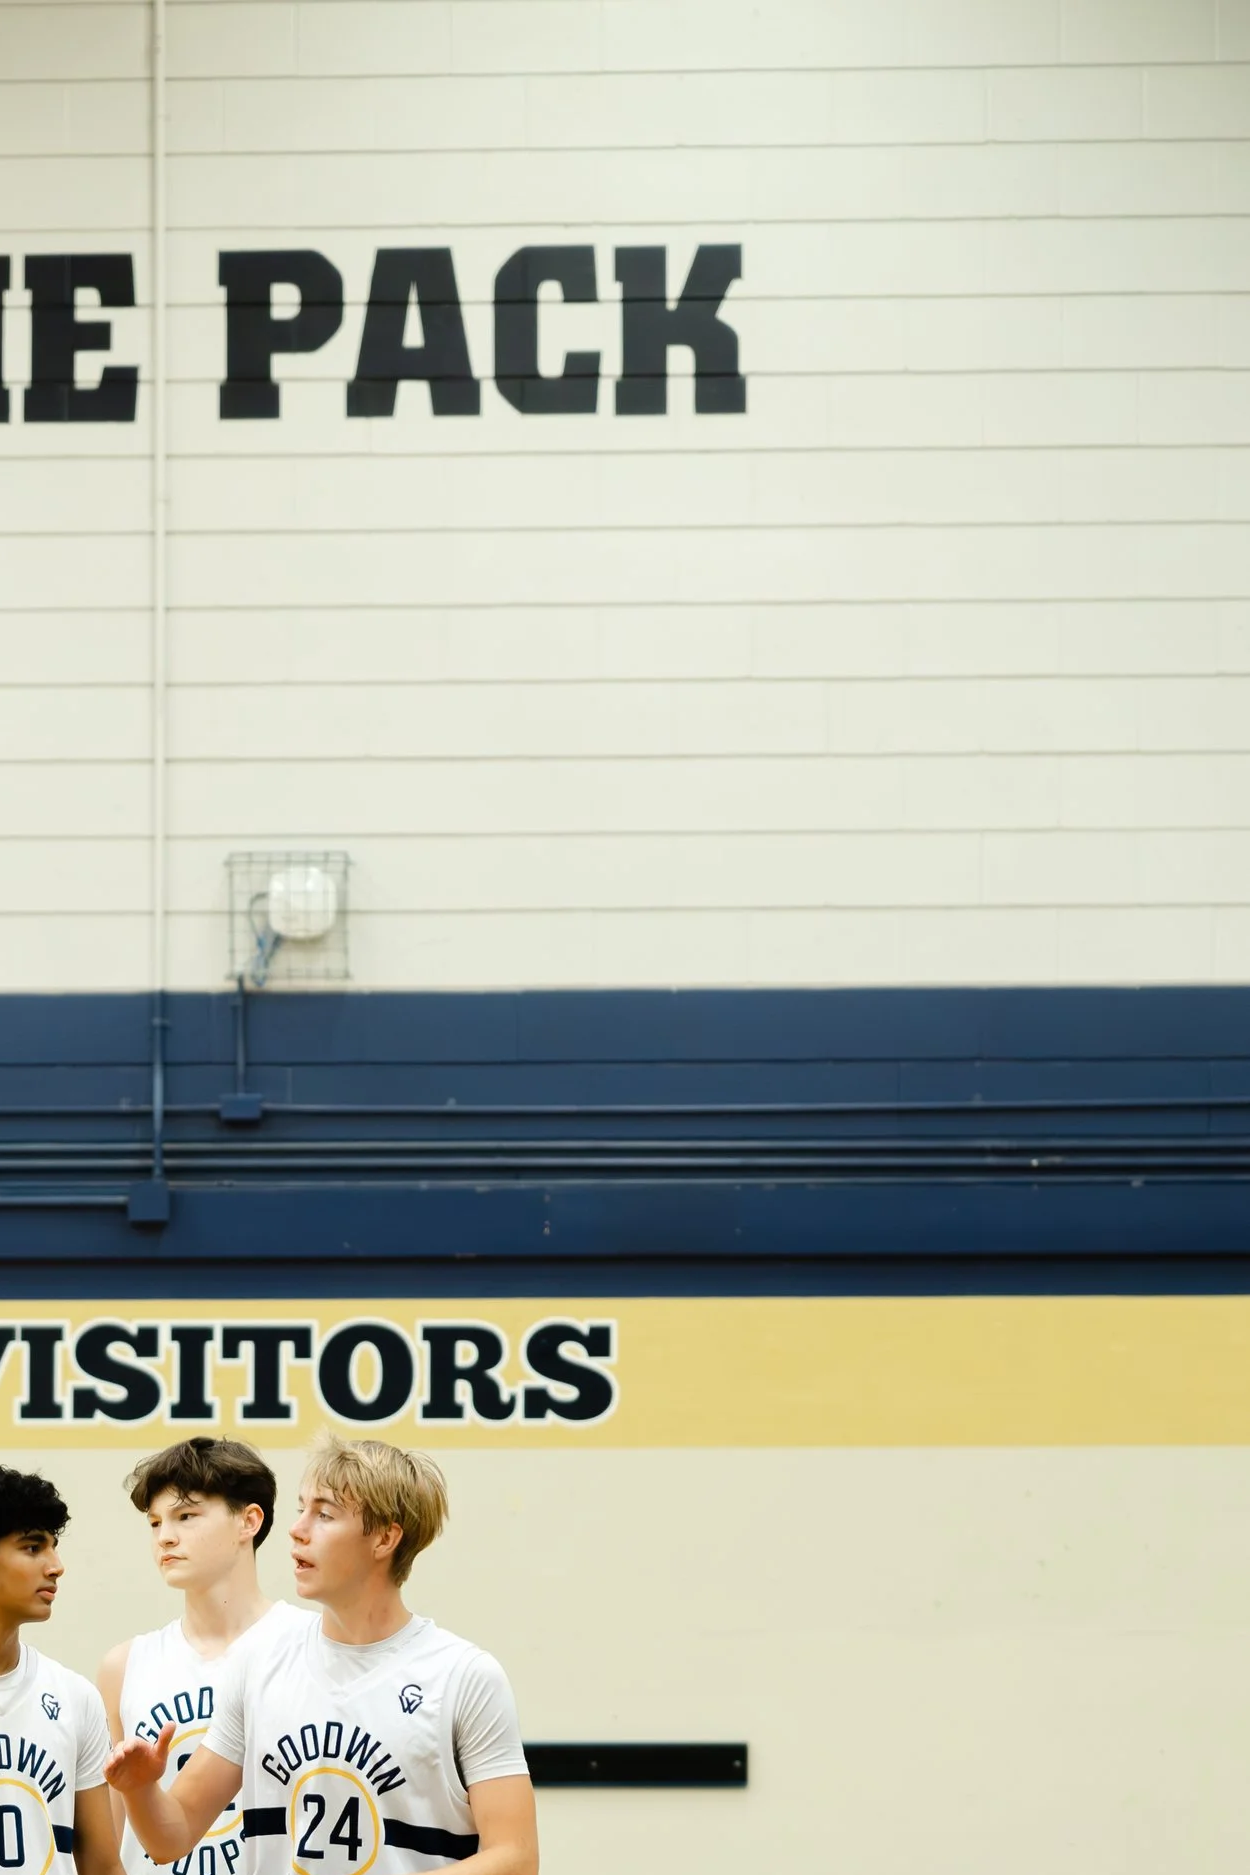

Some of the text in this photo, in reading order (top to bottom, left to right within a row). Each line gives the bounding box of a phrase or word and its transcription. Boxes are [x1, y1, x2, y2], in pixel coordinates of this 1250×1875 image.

[218, 243, 747, 418] PACK
[134, 1685, 214, 1743] GOOD
[261, 1721, 406, 1797] GOODWIN
[296, 1793, 364, 1862] 24
